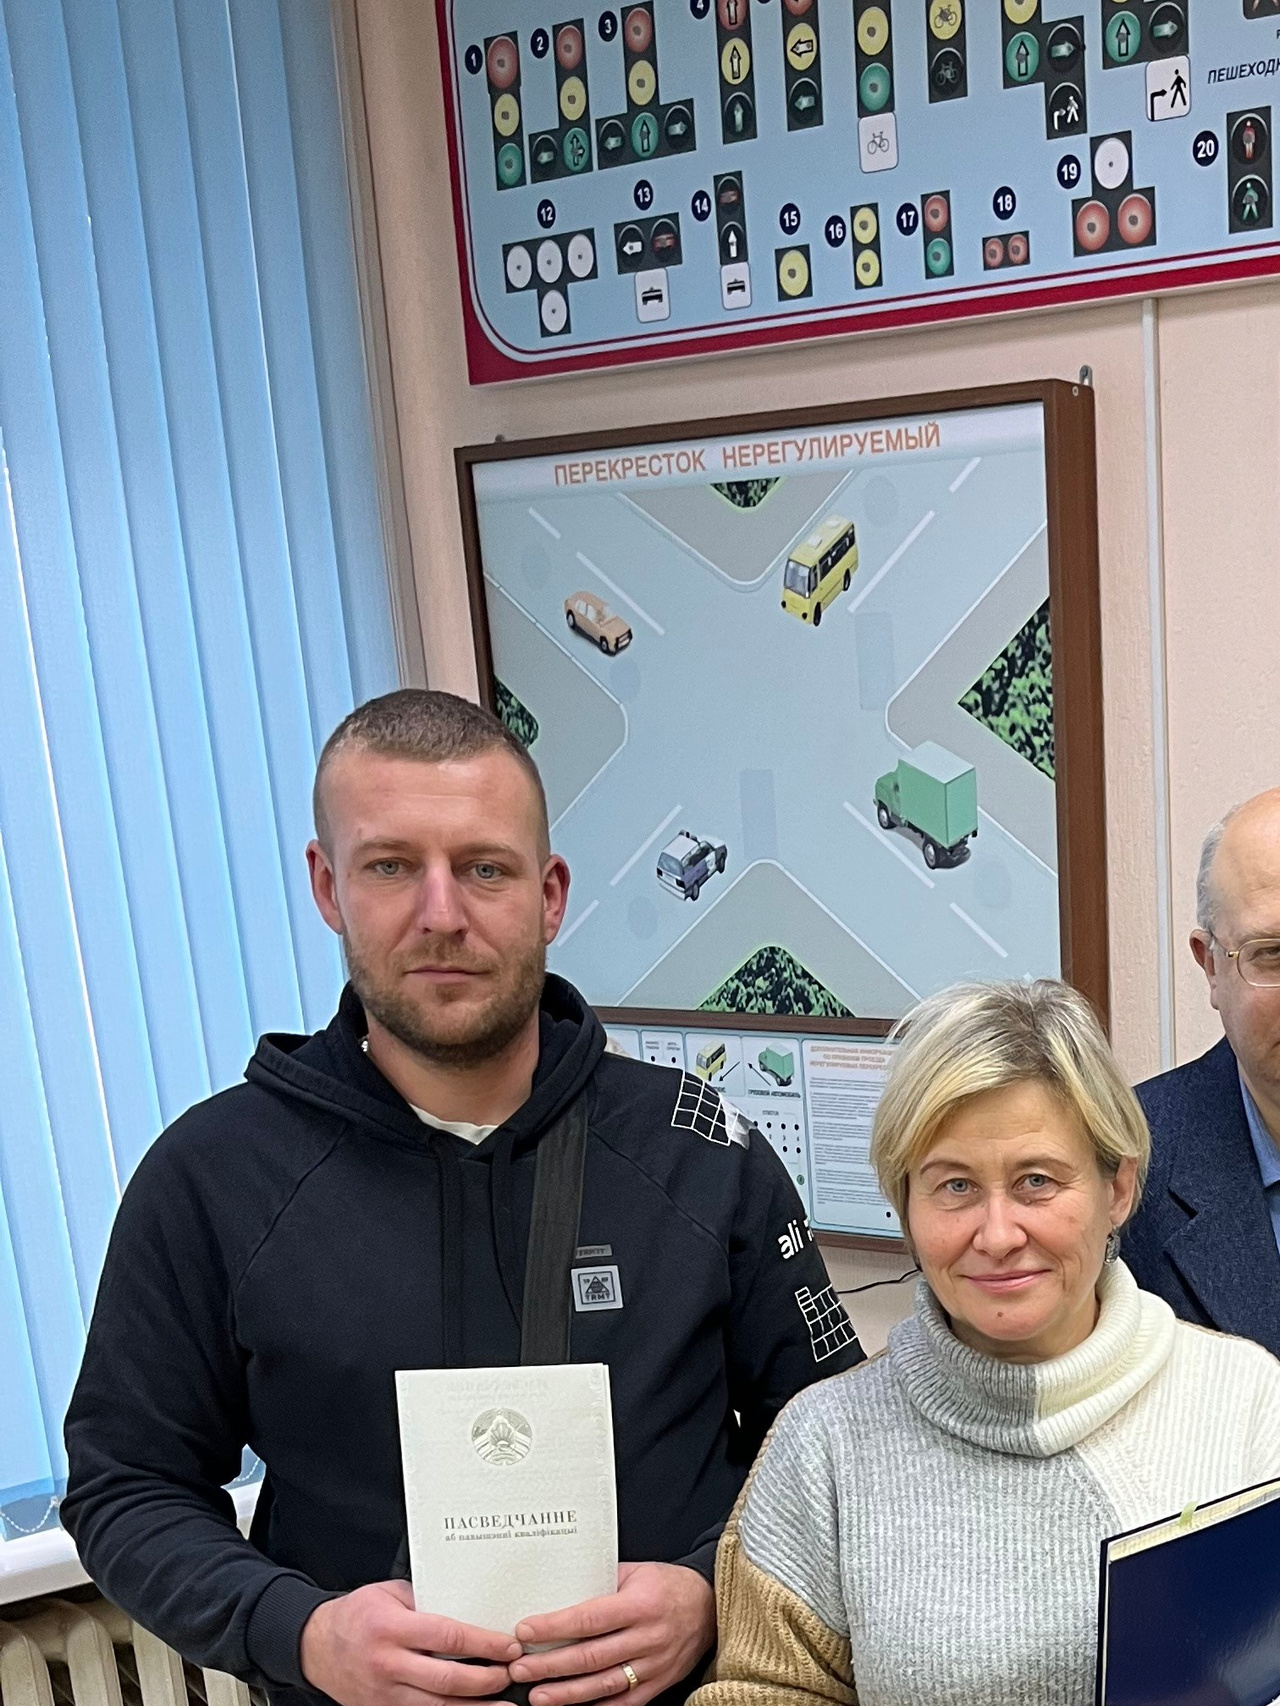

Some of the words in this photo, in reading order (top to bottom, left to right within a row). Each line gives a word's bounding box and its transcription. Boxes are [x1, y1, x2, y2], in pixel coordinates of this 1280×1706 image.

[605, 19, 613, 34] 3
[536, 36, 544, 51] 2
[1197, 140, 1215, 158] 20
[1061, 163, 1078, 182] 19
[637, 187, 651, 204] 13
[997, 194, 1012, 212] 18
[541, 206, 554, 223] 12
[694, 197, 708, 215] 14
[783, 210, 798, 227] 15
[901, 210, 915, 228] 17
[828, 223, 843, 240] 16
[555, 448, 705, 487] ПЕРЕКРЕСТОК
[722, 421, 941, 469] НЕРЕГУЛИРУЕМЫЙ
[444, 1510, 577, 1529] ПАСВЕДЧАННЕ
